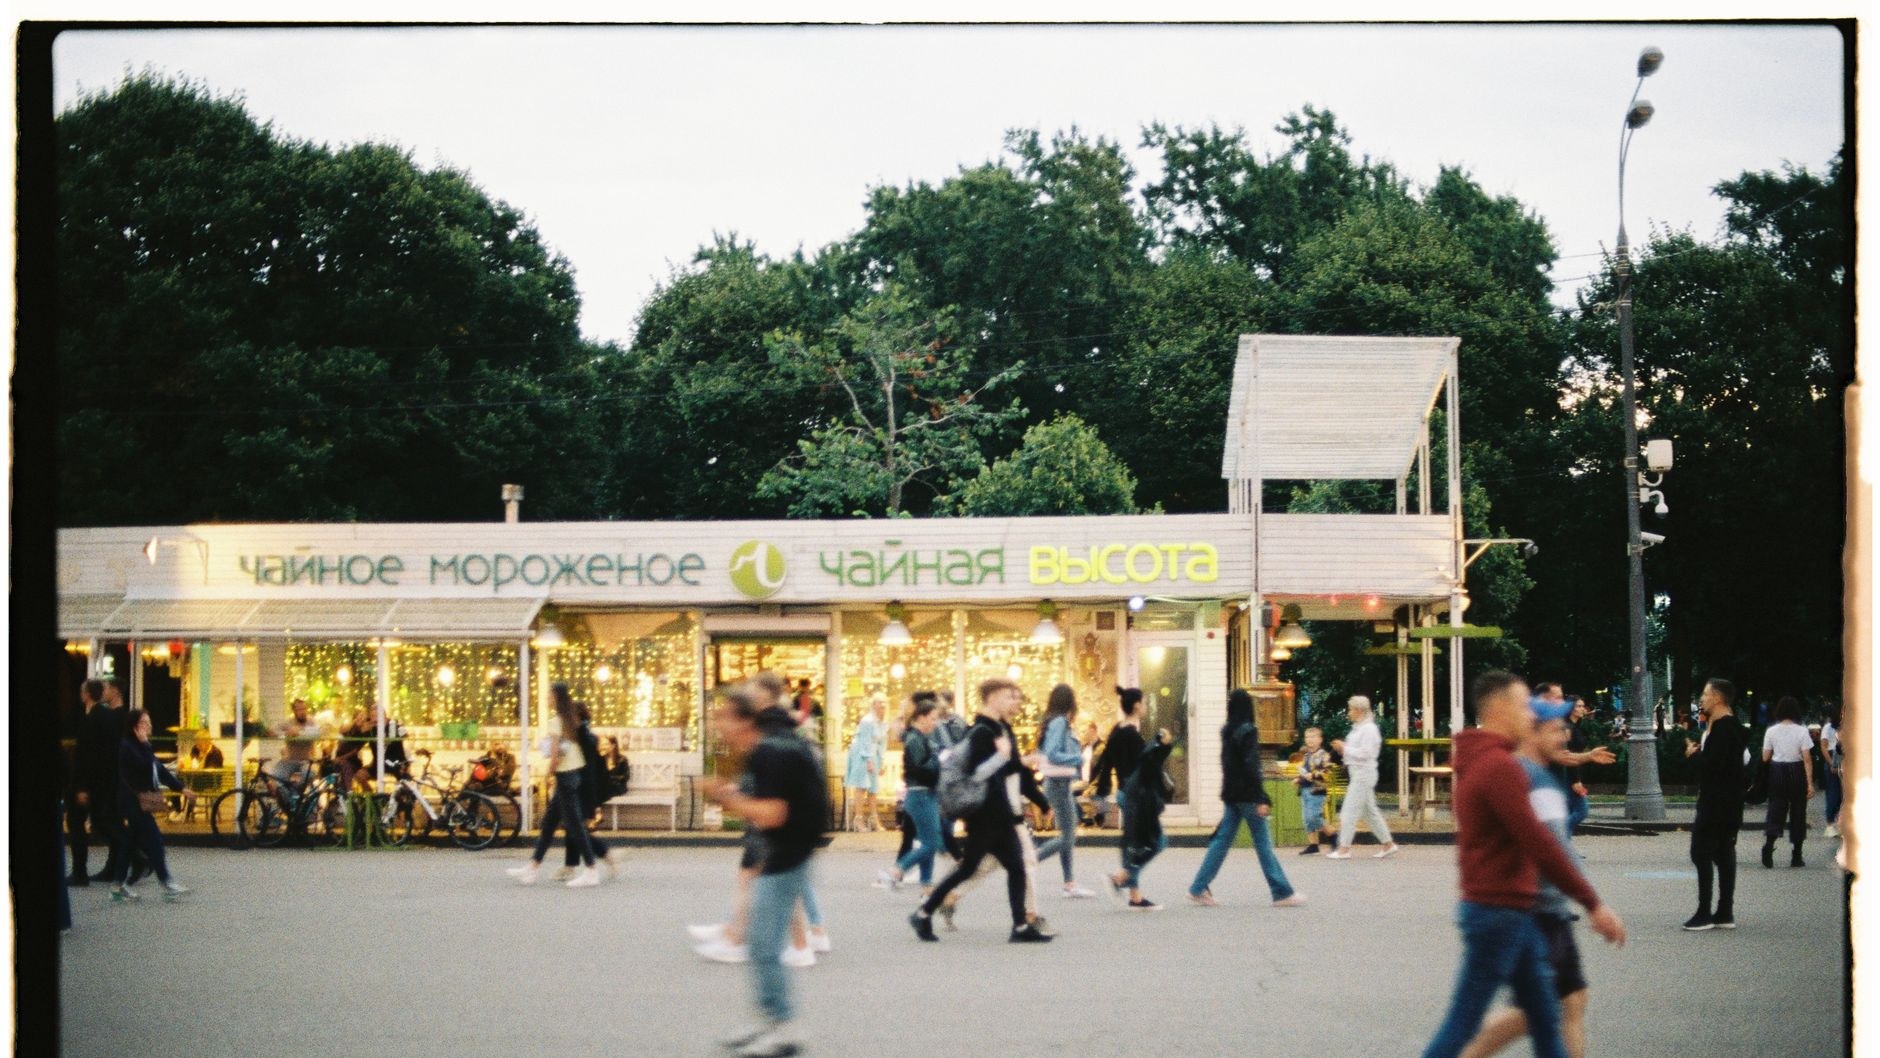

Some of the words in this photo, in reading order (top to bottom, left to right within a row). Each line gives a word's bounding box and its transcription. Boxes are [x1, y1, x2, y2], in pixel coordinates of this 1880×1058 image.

[240, 547, 405, 586] чайное
[430, 553, 706, 592] мороженое
[819, 540, 1004, 587] чайная
[1029, 543, 1219, 585] высота
